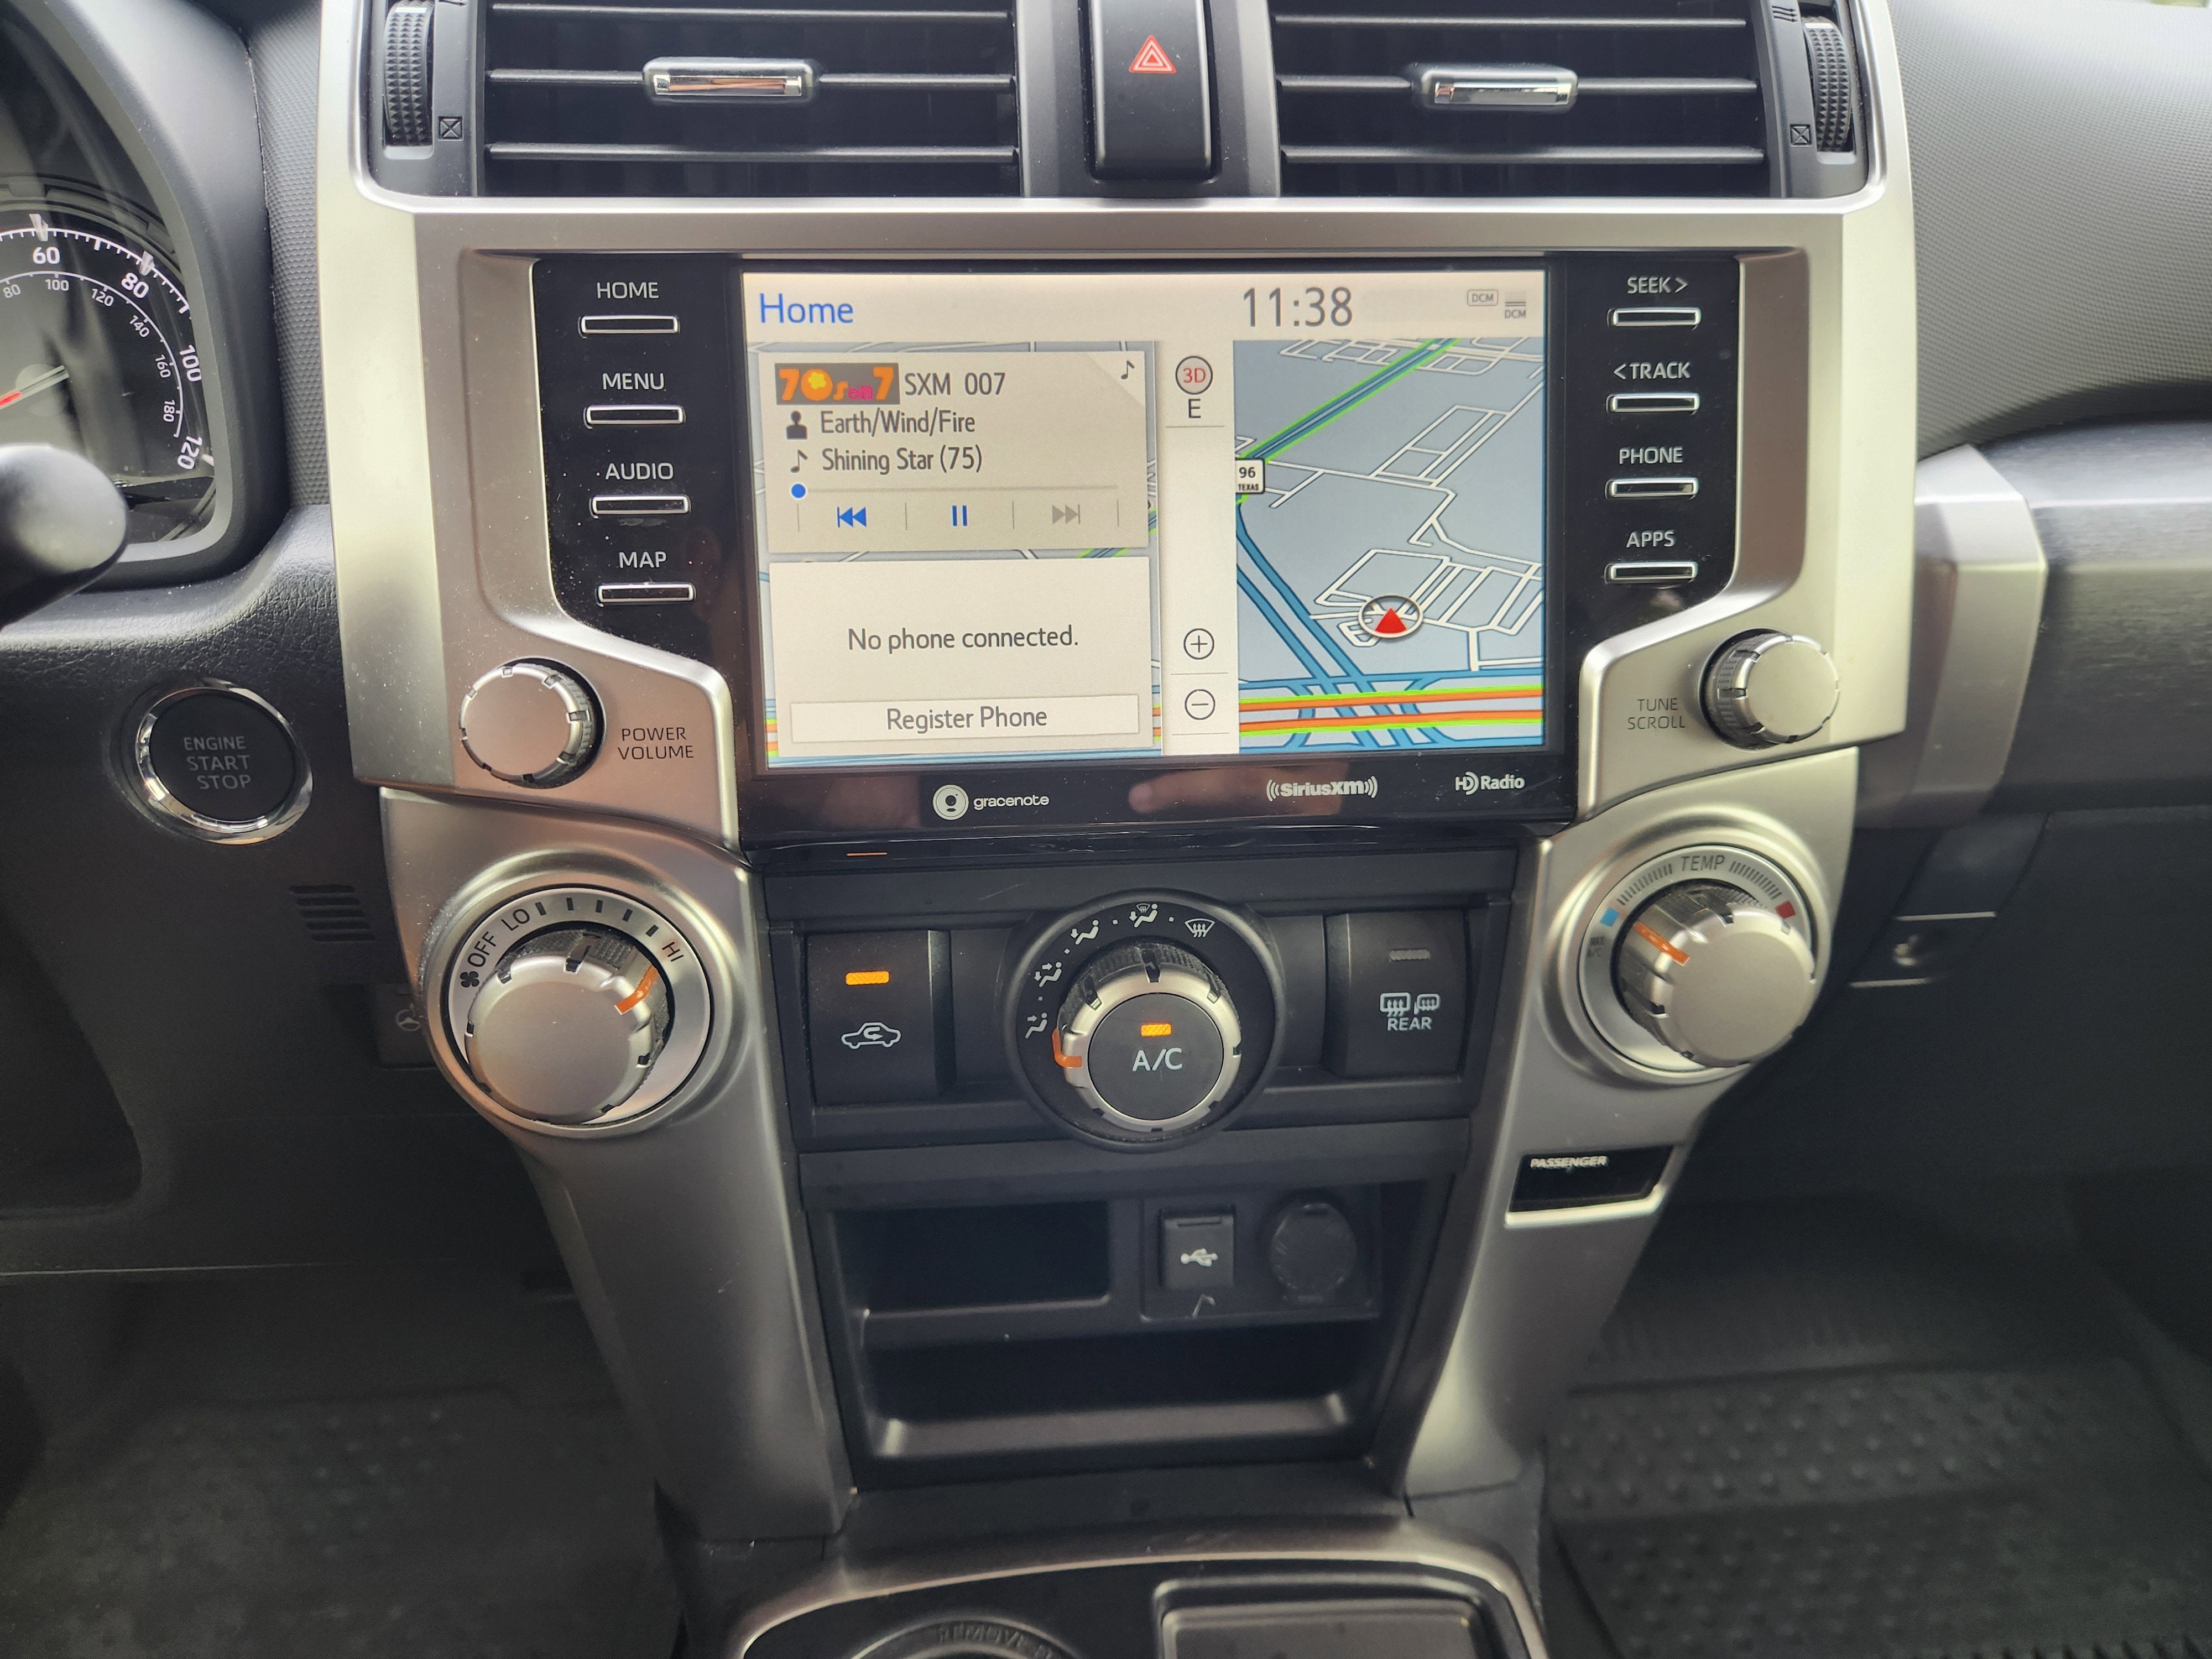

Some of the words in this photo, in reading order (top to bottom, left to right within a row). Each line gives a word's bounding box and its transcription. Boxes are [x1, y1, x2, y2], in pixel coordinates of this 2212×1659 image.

[33, 247, 60, 264] 60
[3, 284, 21, 298] 80
[45, 279, 69, 291] 100
[121, 273, 149, 298] 80
[597, 282, 659, 299] HOME
[91, 288, 114, 306] 120
[1472, 293, 1494, 302] DCM
[760, 293, 854, 324] Home
[1243, 286, 1353, 327] 11:38
[1505, 309, 1526, 319] DCM
[129, 315, 150, 338] 140
[155, 354, 171, 379] 160
[179, 345, 202, 382] 100
[602, 372, 665, 390] MENU
[905, 372, 951, 397] SXM
[964, 372, 1006, 397] 007
[1182, 367, 1207, 385] 3D
[163, 399, 175, 422] 180
[1187, 398, 1202, 419] E
[821, 406, 975, 437] Earth/Wind/Fire
[177, 435, 203, 469] 120
[822, 447, 890, 476] Shining
[896, 447, 934, 472] Star
[940, 444, 983, 473] (75)
[1619, 446, 1683, 465] PHONE
[605, 463, 674, 481] AUDIO
[1239, 467, 1256, 478] 96
[1626, 531, 1676, 548] APPS
[619, 551, 667, 568] MAP
[848, 628, 881, 651] No
[889, 627, 955, 654] phone
[962, 625, 1079, 648] connected.
[1637, 698, 1678, 712] TUNE
[886, 708, 974, 734] Register
[980, 706, 1048, 728] Phone
[1627, 716, 1686, 731] SCROLL
[183, 736, 247, 751] ENGINE
[622, 727, 686, 742] POWER
[617, 745, 694, 760] VOLUME
[187, 754, 250, 771] START
[196, 774, 252, 790] STOP
[1480, 775, 1525, 791] Radio
[973, 795, 1050, 811] gracenote
[1681, 854, 1725, 872] TEMP
[501, 907, 531, 932] LO
[467, 931, 497, 968] OFF
[661, 941, 684, 963] HI
[1386, 1016, 1432, 1031] REAR
[1132, 1047, 1183, 1072] A/C
[1530, 1155, 1608, 1168] PASSENGER
